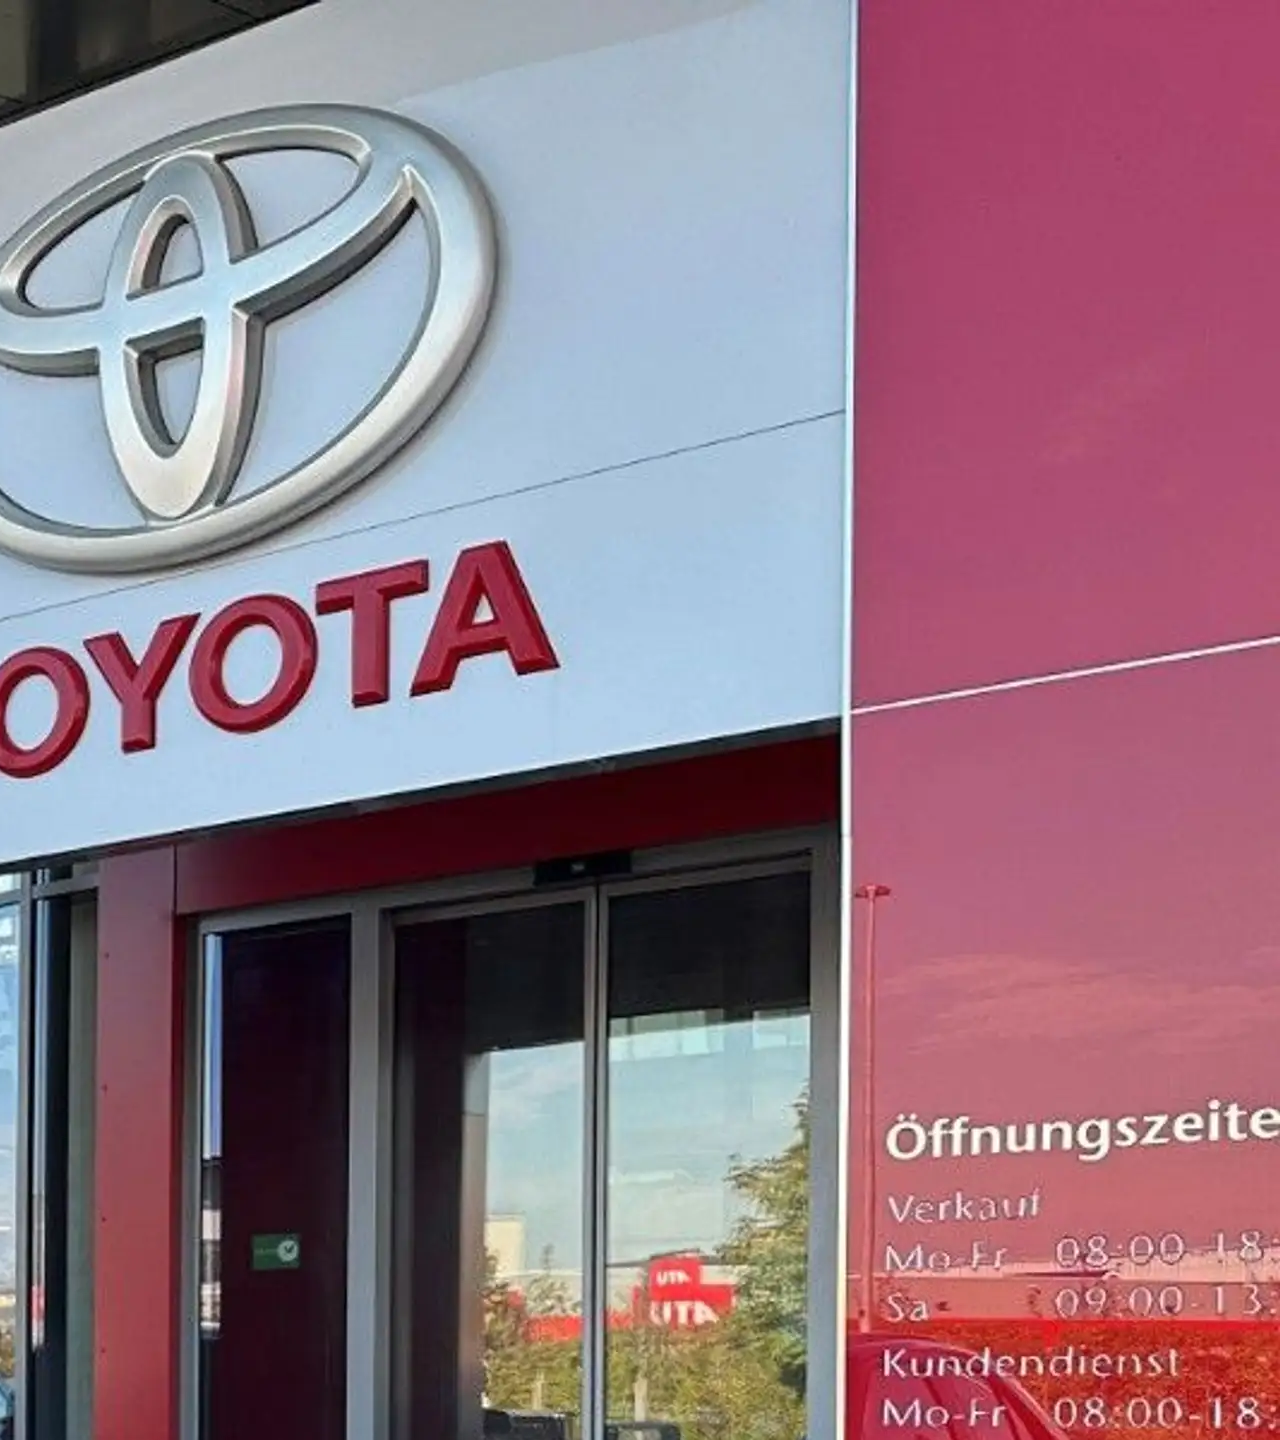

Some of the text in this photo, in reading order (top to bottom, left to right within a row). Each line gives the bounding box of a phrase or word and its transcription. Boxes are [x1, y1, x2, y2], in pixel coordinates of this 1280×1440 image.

[886, 1099, 1280, 1161] Öffnungszeite
[889, 1188, 1040, 1223] Verkauf
[886, 1292, 930, 1321] Sa
[883, 1347, 1180, 1378] Kundendienst
[883, 1399, 1008, 1428] Mo-Fr
